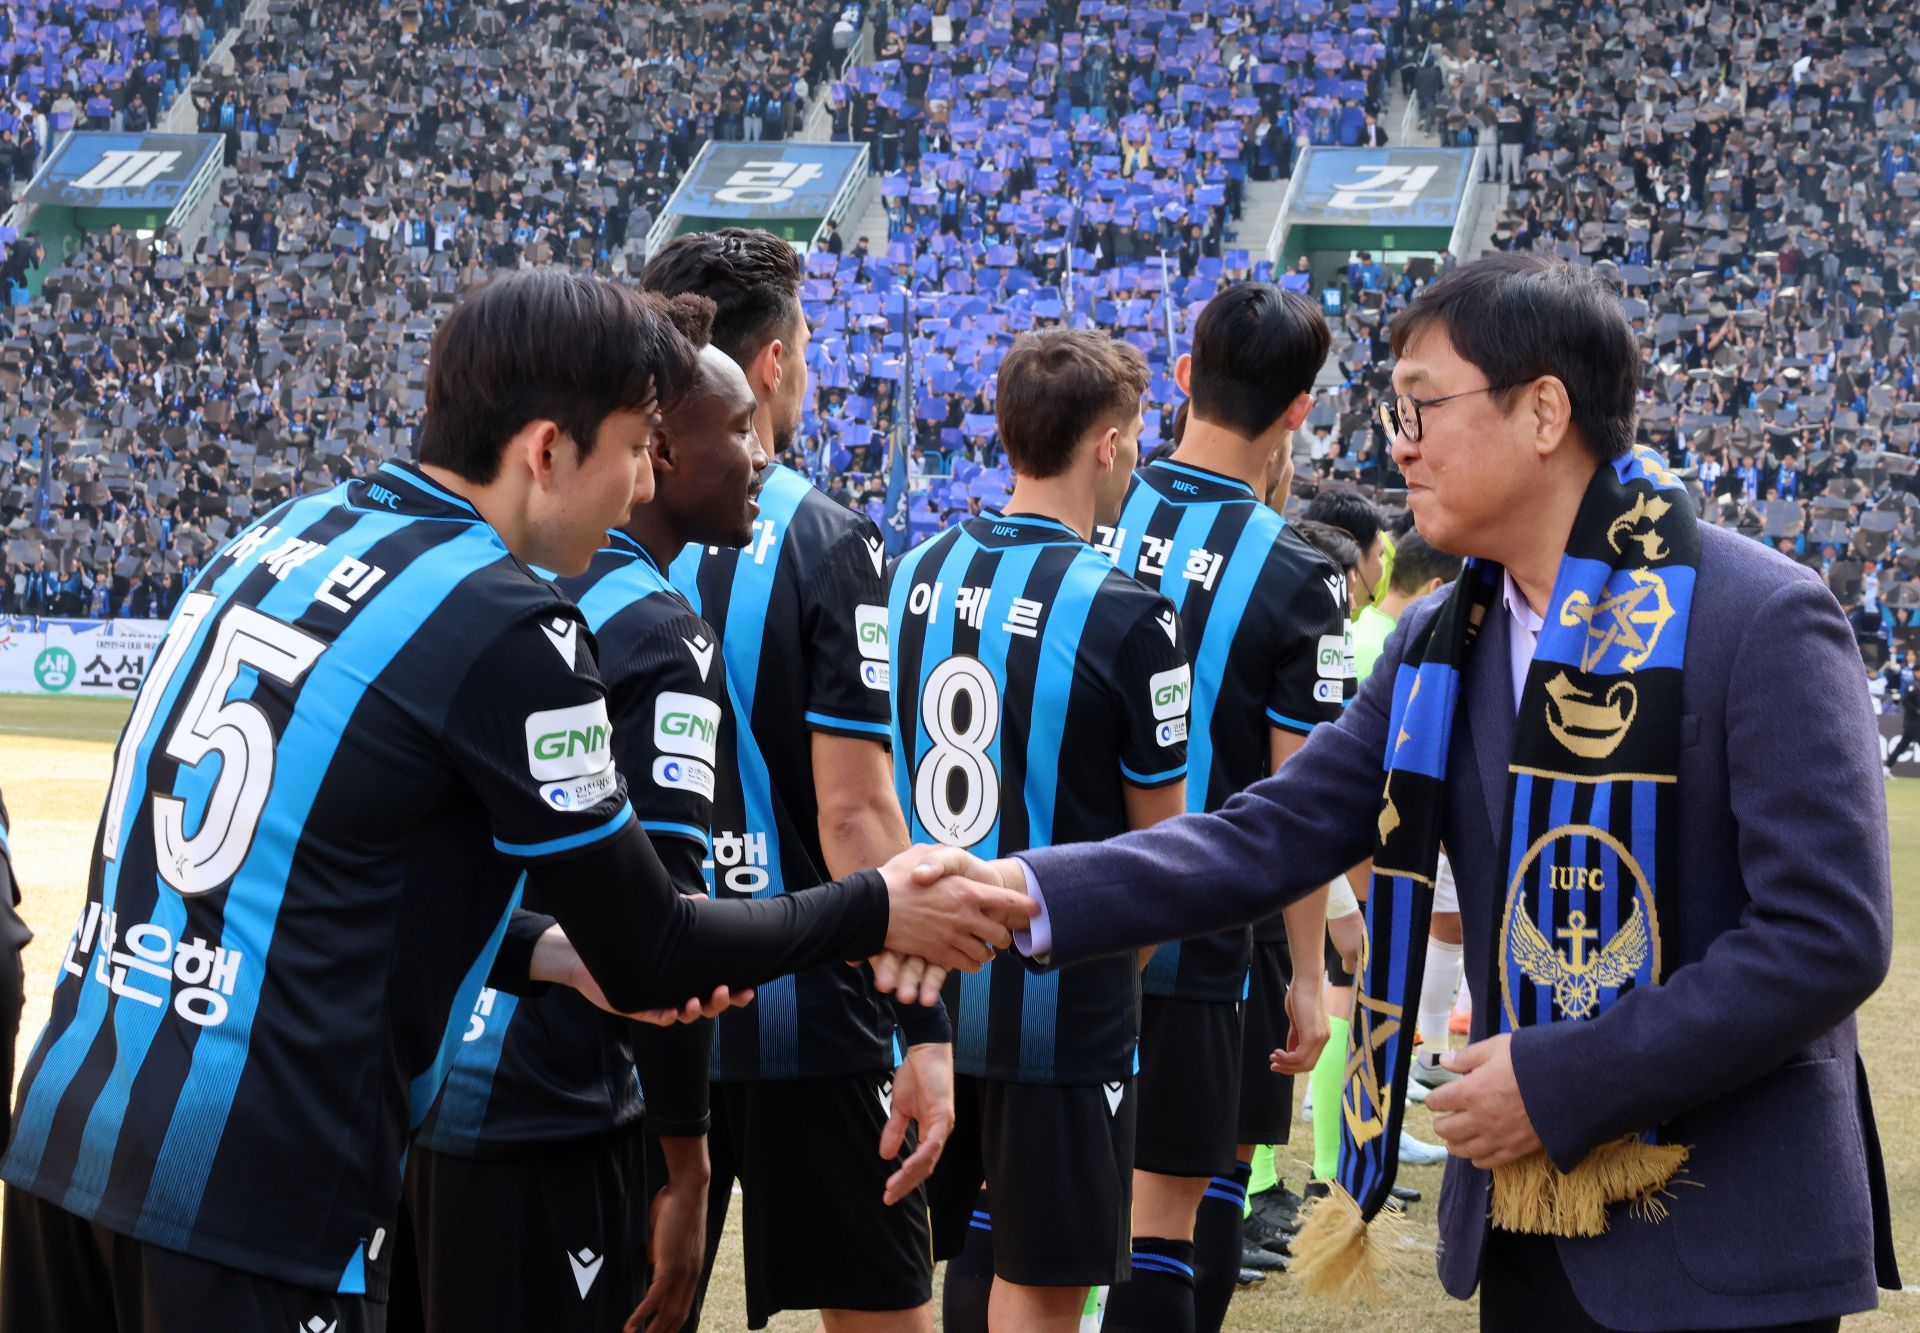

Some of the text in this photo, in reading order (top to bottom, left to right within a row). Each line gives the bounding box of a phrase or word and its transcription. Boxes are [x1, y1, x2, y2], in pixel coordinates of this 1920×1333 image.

[714, 161, 824, 204] 랑
[1327, 165, 1439, 210] 검
[366, 482, 402, 510] IUFC
[1172, 479, 1200, 495] IUFC
[992, 524, 1019, 538] IUFC
[1094, 525, 1224, 592] 김건희
[909, 582, 1044, 639] 이케르
[38, 653, 70, 687] 생
[914, 654, 1001, 848] 8
[702, 831, 769, 892] 행
[1549, 864, 1605, 892] IUFC
